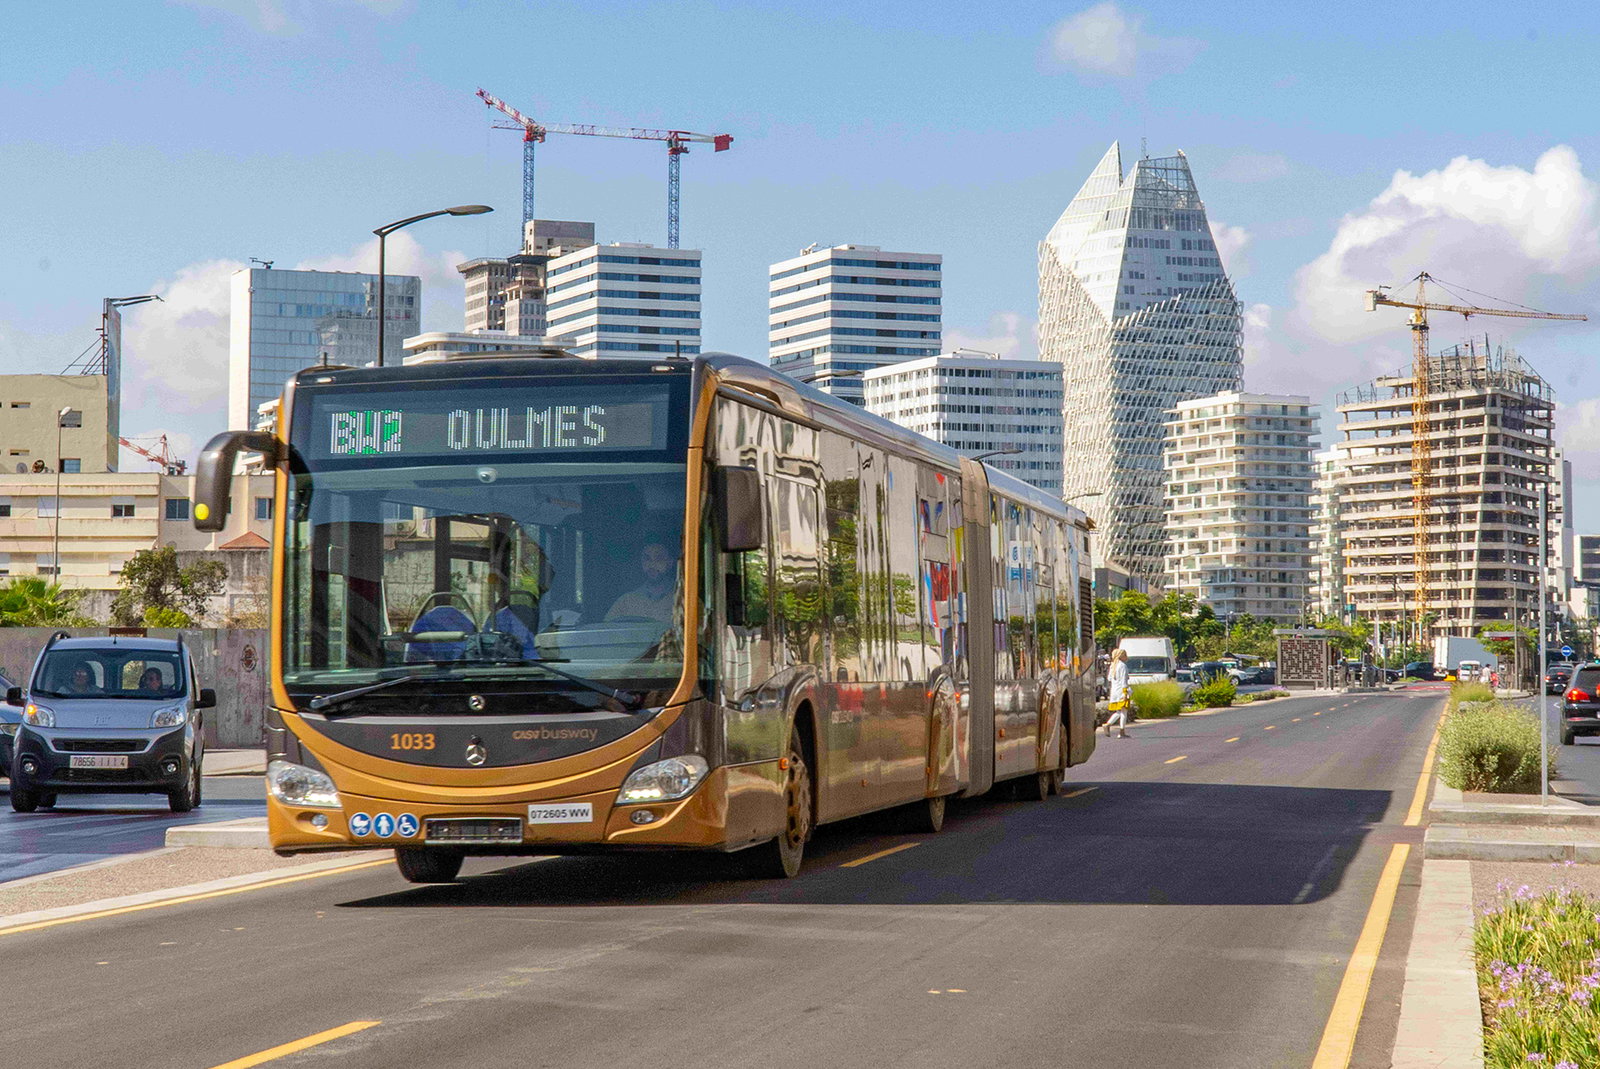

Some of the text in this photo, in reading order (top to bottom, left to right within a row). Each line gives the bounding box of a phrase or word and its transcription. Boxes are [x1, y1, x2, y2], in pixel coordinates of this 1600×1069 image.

[447, 404, 605, 450] OULMES
[391, 733, 436, 750] 1033
[530, 808, 590, 819] 072605 WW
